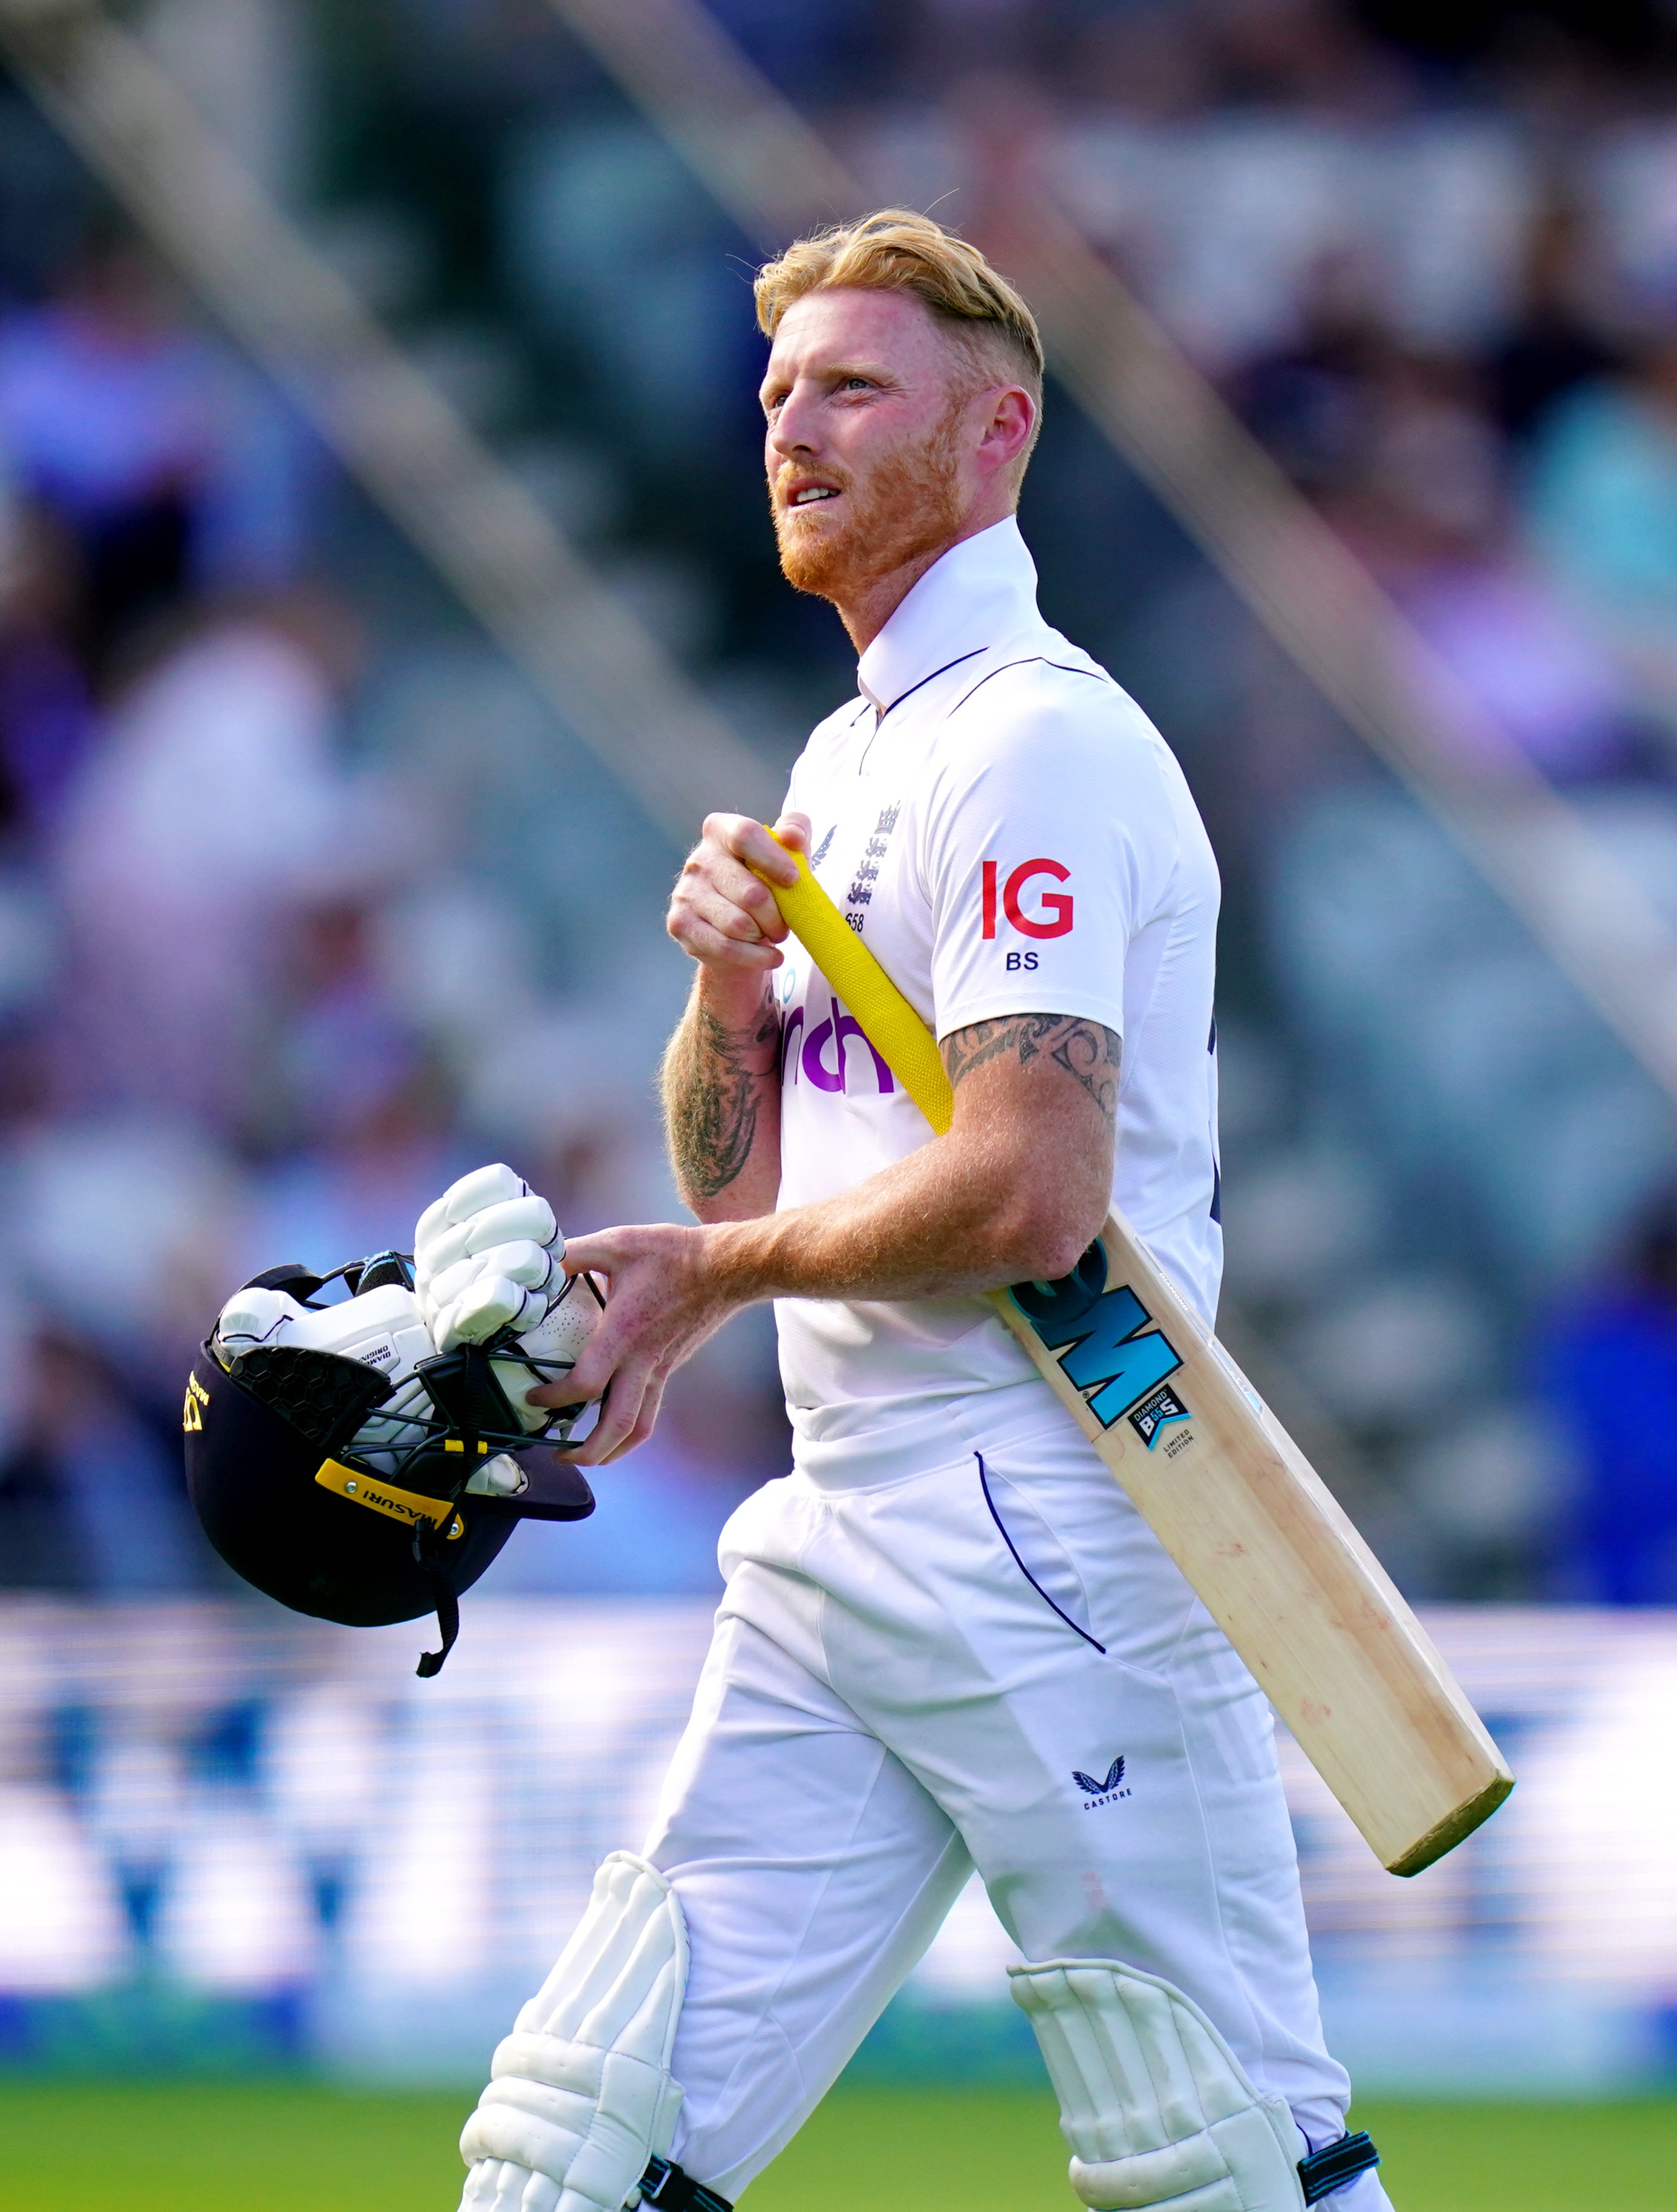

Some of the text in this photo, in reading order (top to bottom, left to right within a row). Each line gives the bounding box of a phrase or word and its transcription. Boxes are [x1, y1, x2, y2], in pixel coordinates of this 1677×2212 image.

[983, 858, 1073, 939] IG
[845, 912, 864, 932] 658
[1006, 952, 1039, 971] BS
[1158, 1272, 1189, 1311] DIAMOND
[1133, 1391, 1168, 1422] DIAMOND
[1163, 1429, 1190, 1452] LIMITED
[1168, 1435, 1194, 1459] EDITION
[1084, 1788, 1132, 1810] CASTORE
